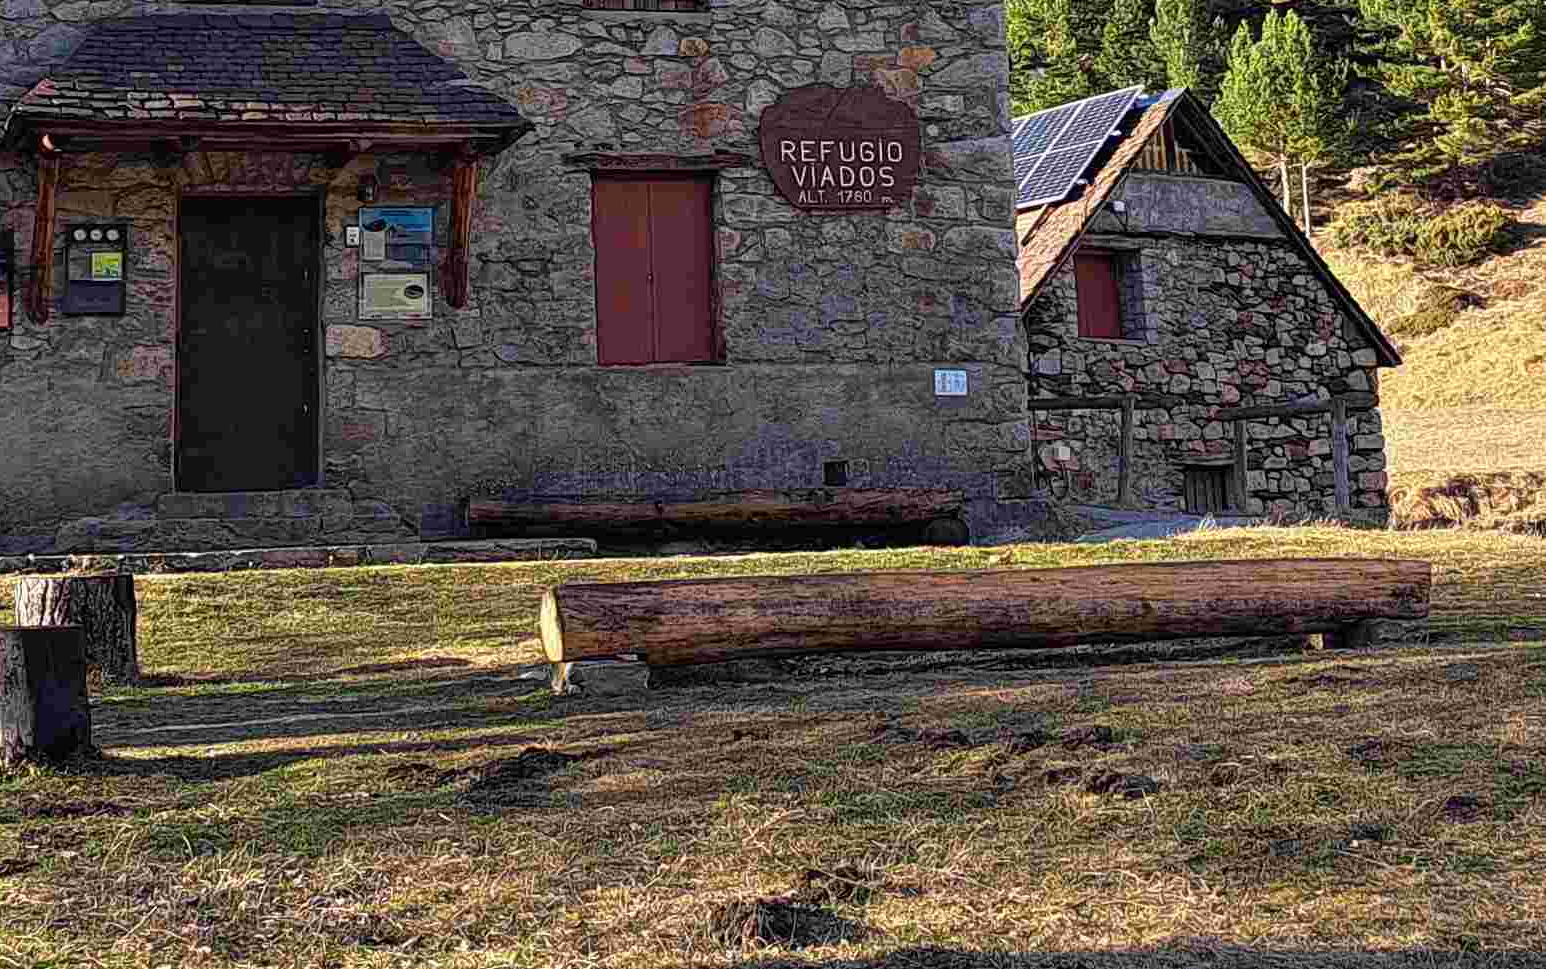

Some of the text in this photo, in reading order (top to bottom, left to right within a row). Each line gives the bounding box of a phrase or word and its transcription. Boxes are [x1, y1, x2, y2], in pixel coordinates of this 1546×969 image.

[780, 139, 903, 163] REFUGIO
[791, 163, 895, 187] VIADOS
[798, 190, 828, 203] ALT.
